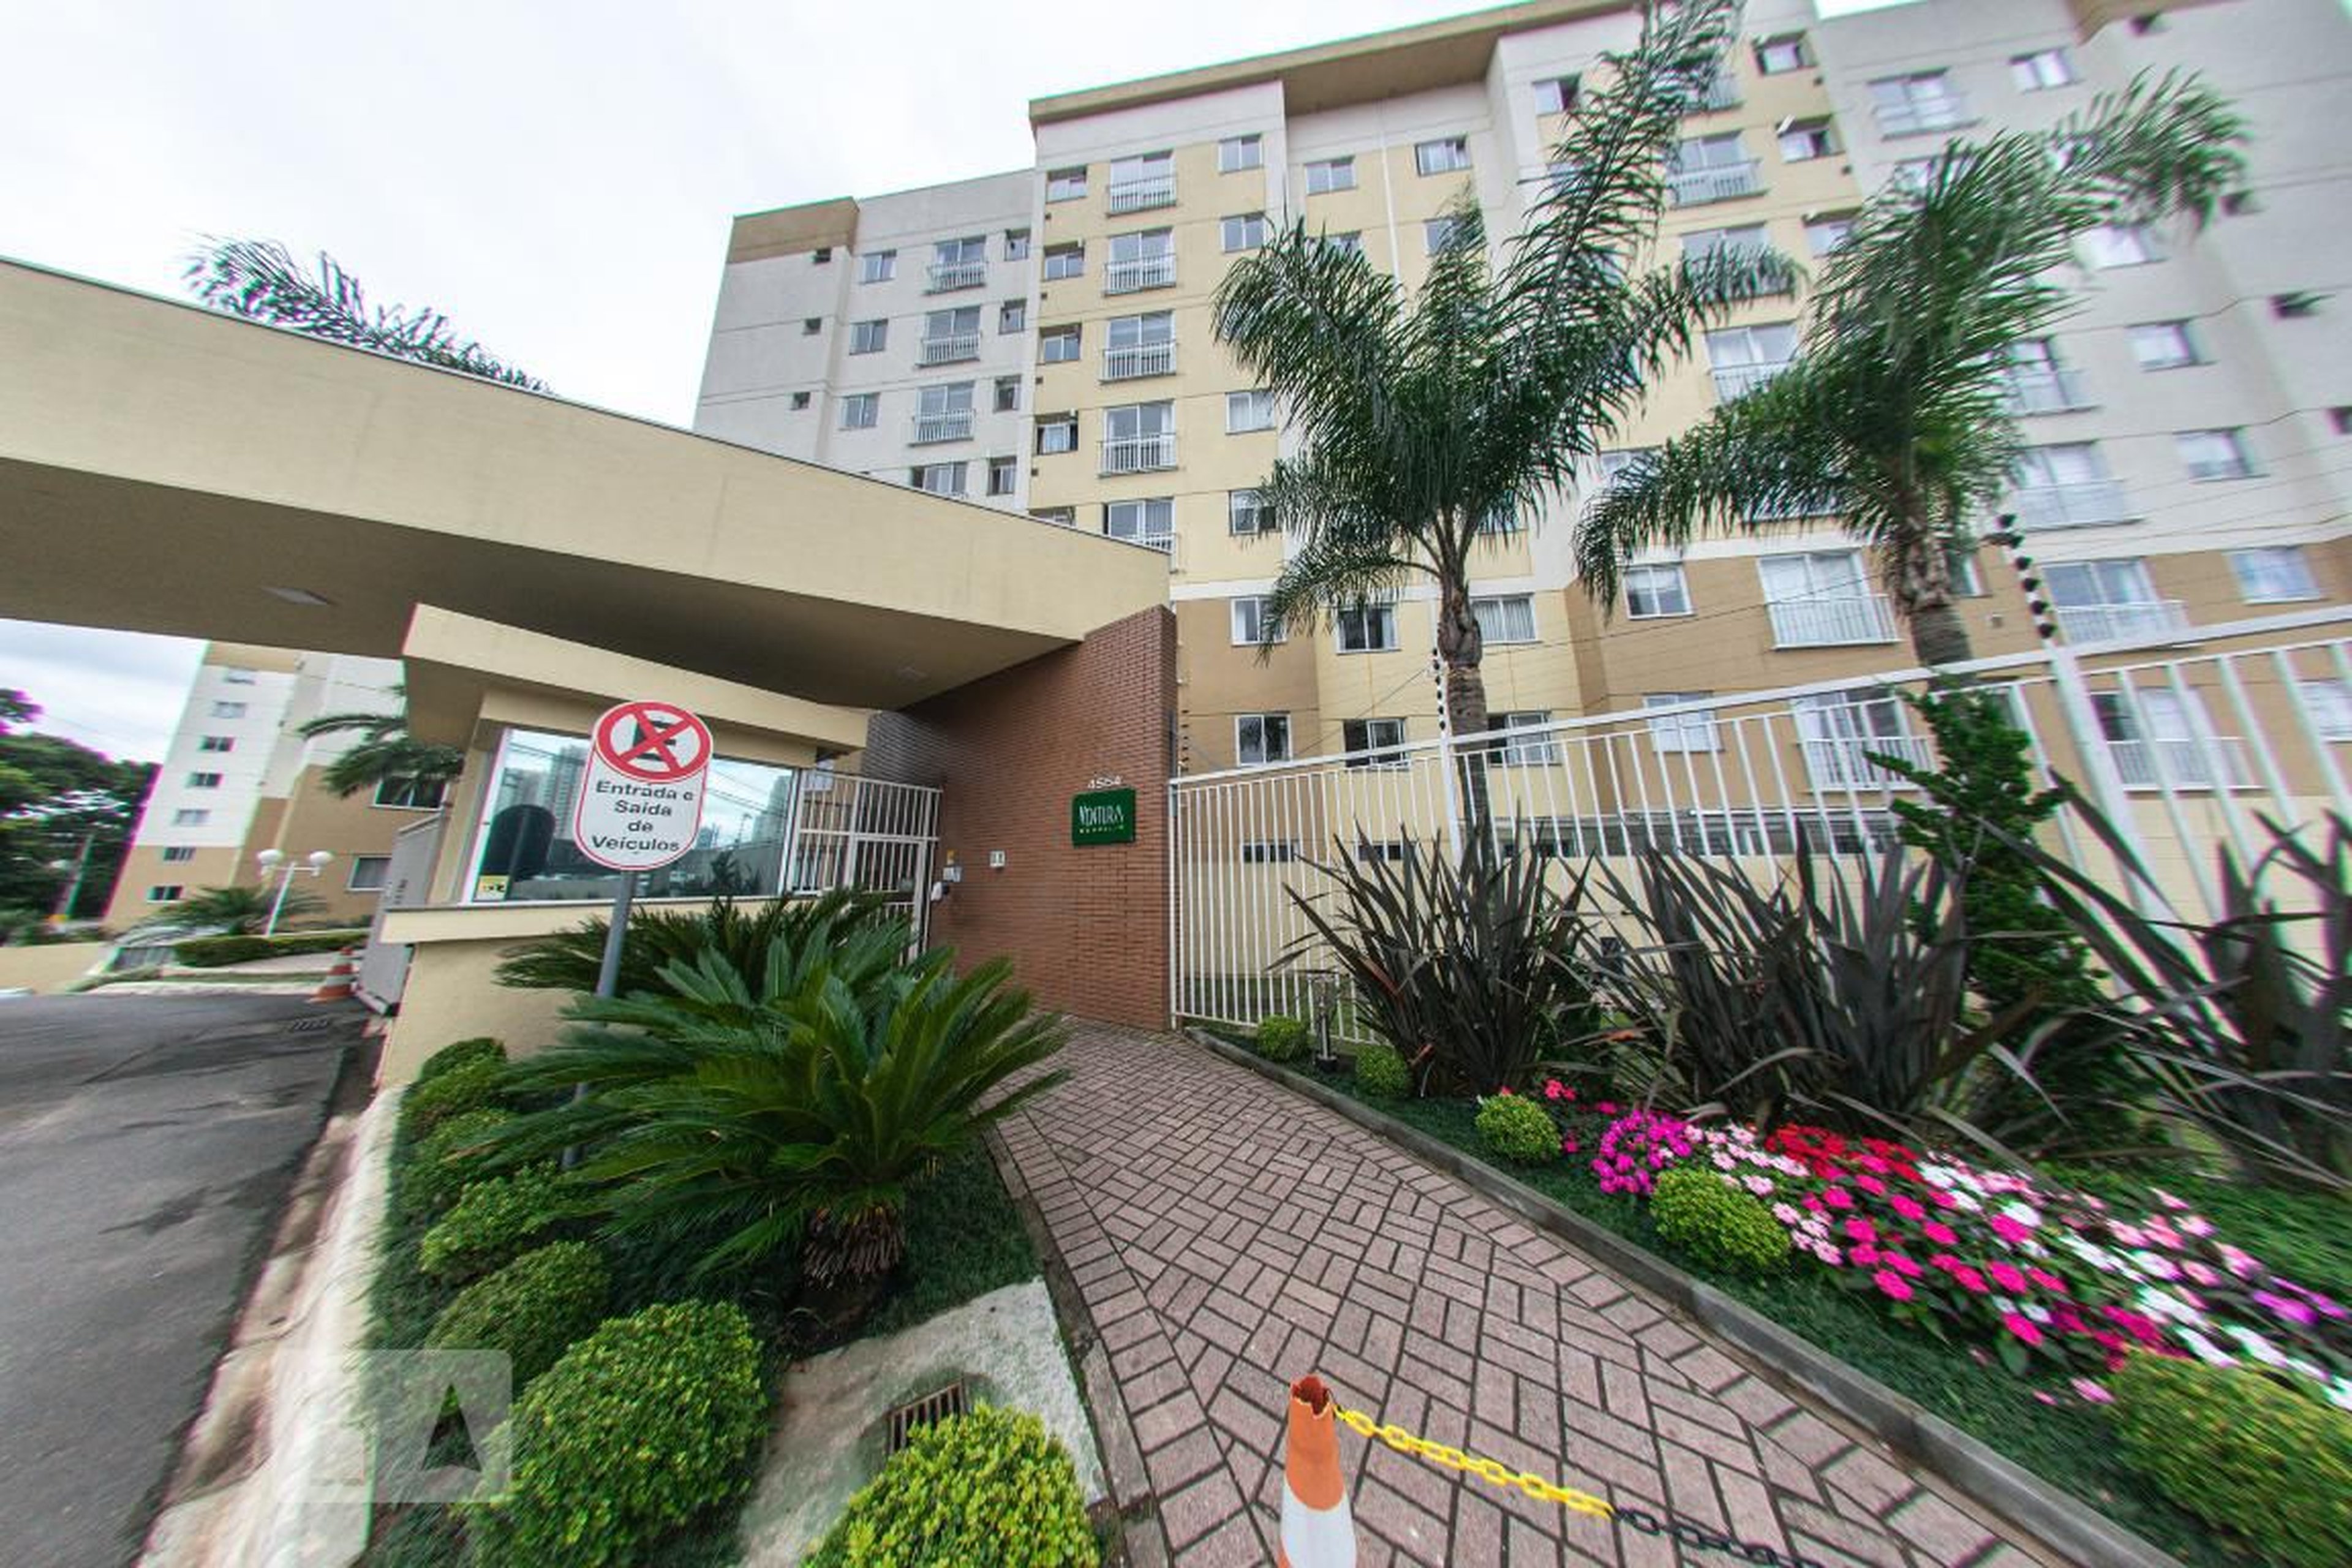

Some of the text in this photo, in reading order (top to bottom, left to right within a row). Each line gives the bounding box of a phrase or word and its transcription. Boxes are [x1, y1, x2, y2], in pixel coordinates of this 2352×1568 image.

[596, 780, 694, 801] Entrada e
[627, 820, 654, 832] de
